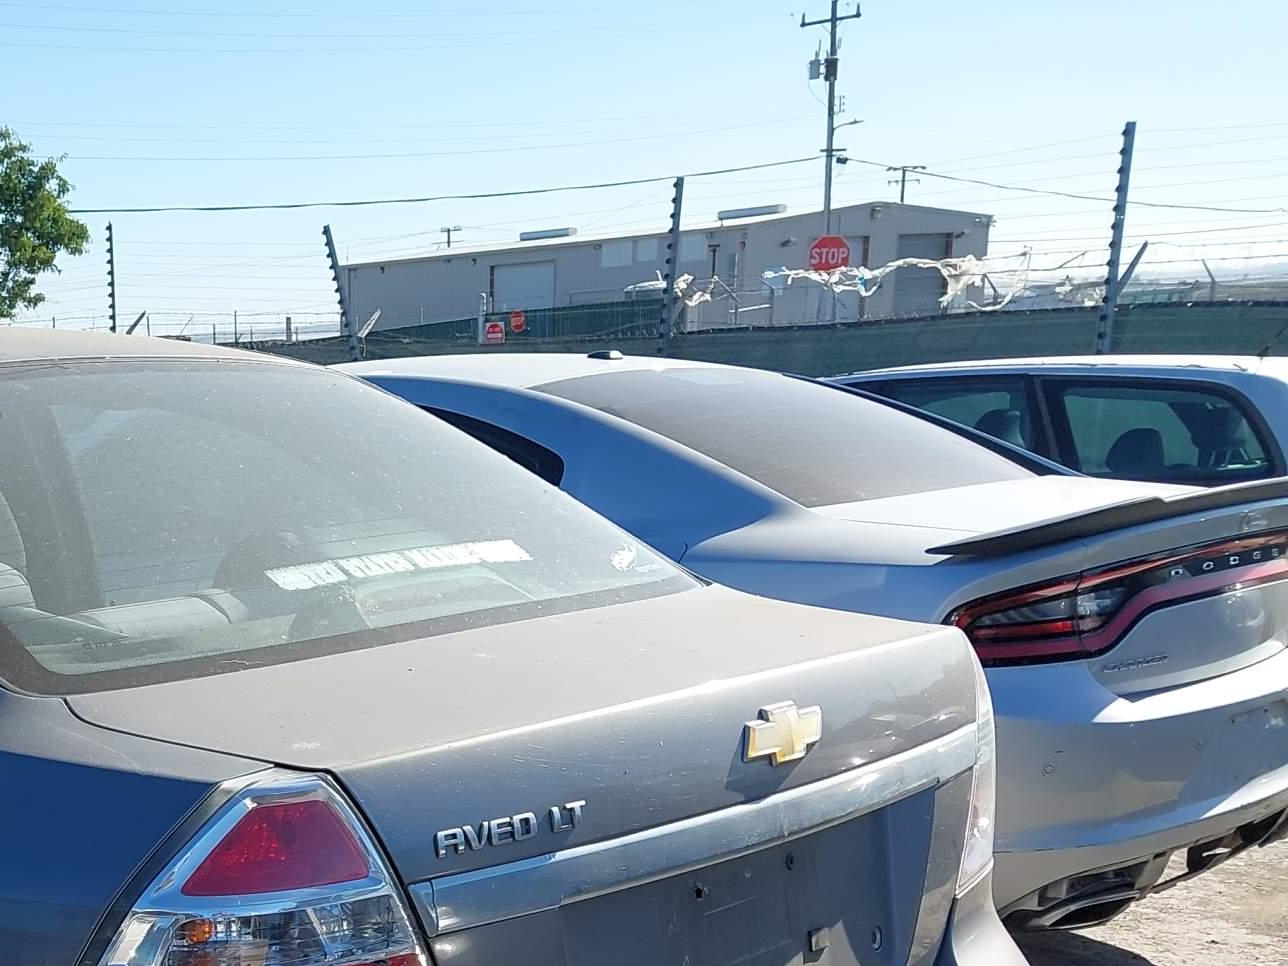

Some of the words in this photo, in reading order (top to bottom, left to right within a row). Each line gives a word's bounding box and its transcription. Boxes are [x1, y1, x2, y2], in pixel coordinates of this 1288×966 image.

[811, 248, 848, 265] STOP
[1170, 548, 1281, 577] DODGE
[434, 811, 538, 859] AVEO
[549, 799, 587, 834] LT
